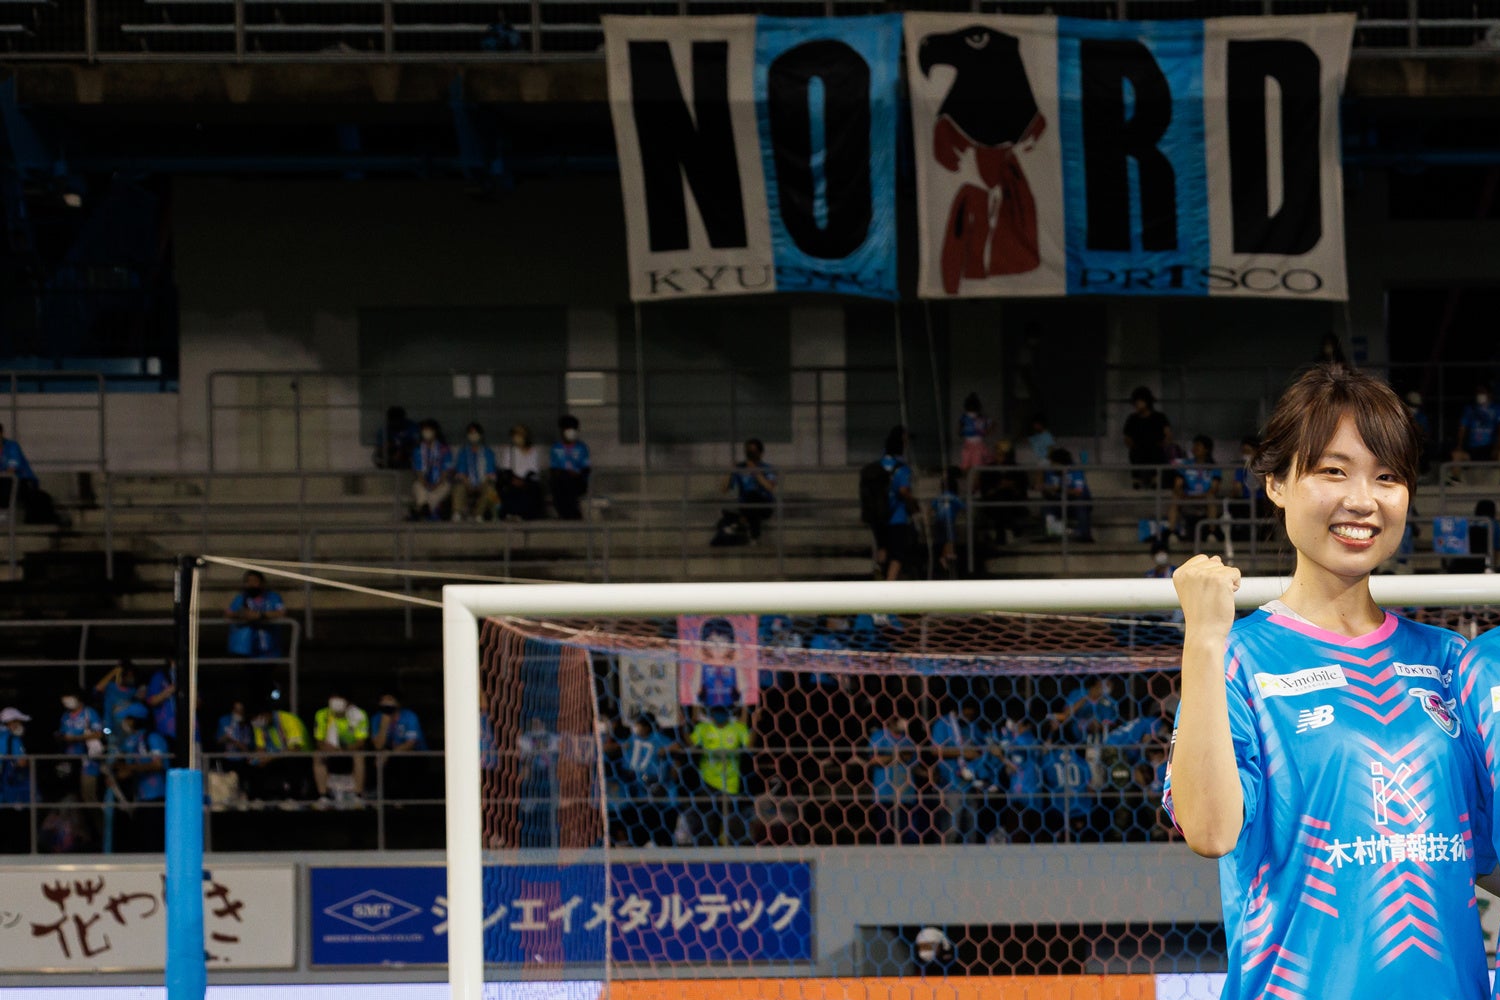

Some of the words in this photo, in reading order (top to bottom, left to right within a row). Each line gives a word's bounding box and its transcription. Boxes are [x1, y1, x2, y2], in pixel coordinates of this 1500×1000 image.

[1398, 665, 1432, 675] TOKYO
[1325, 834, 1467, 869] 木村情報技術
[31, 873, 245, 959] 花やき
